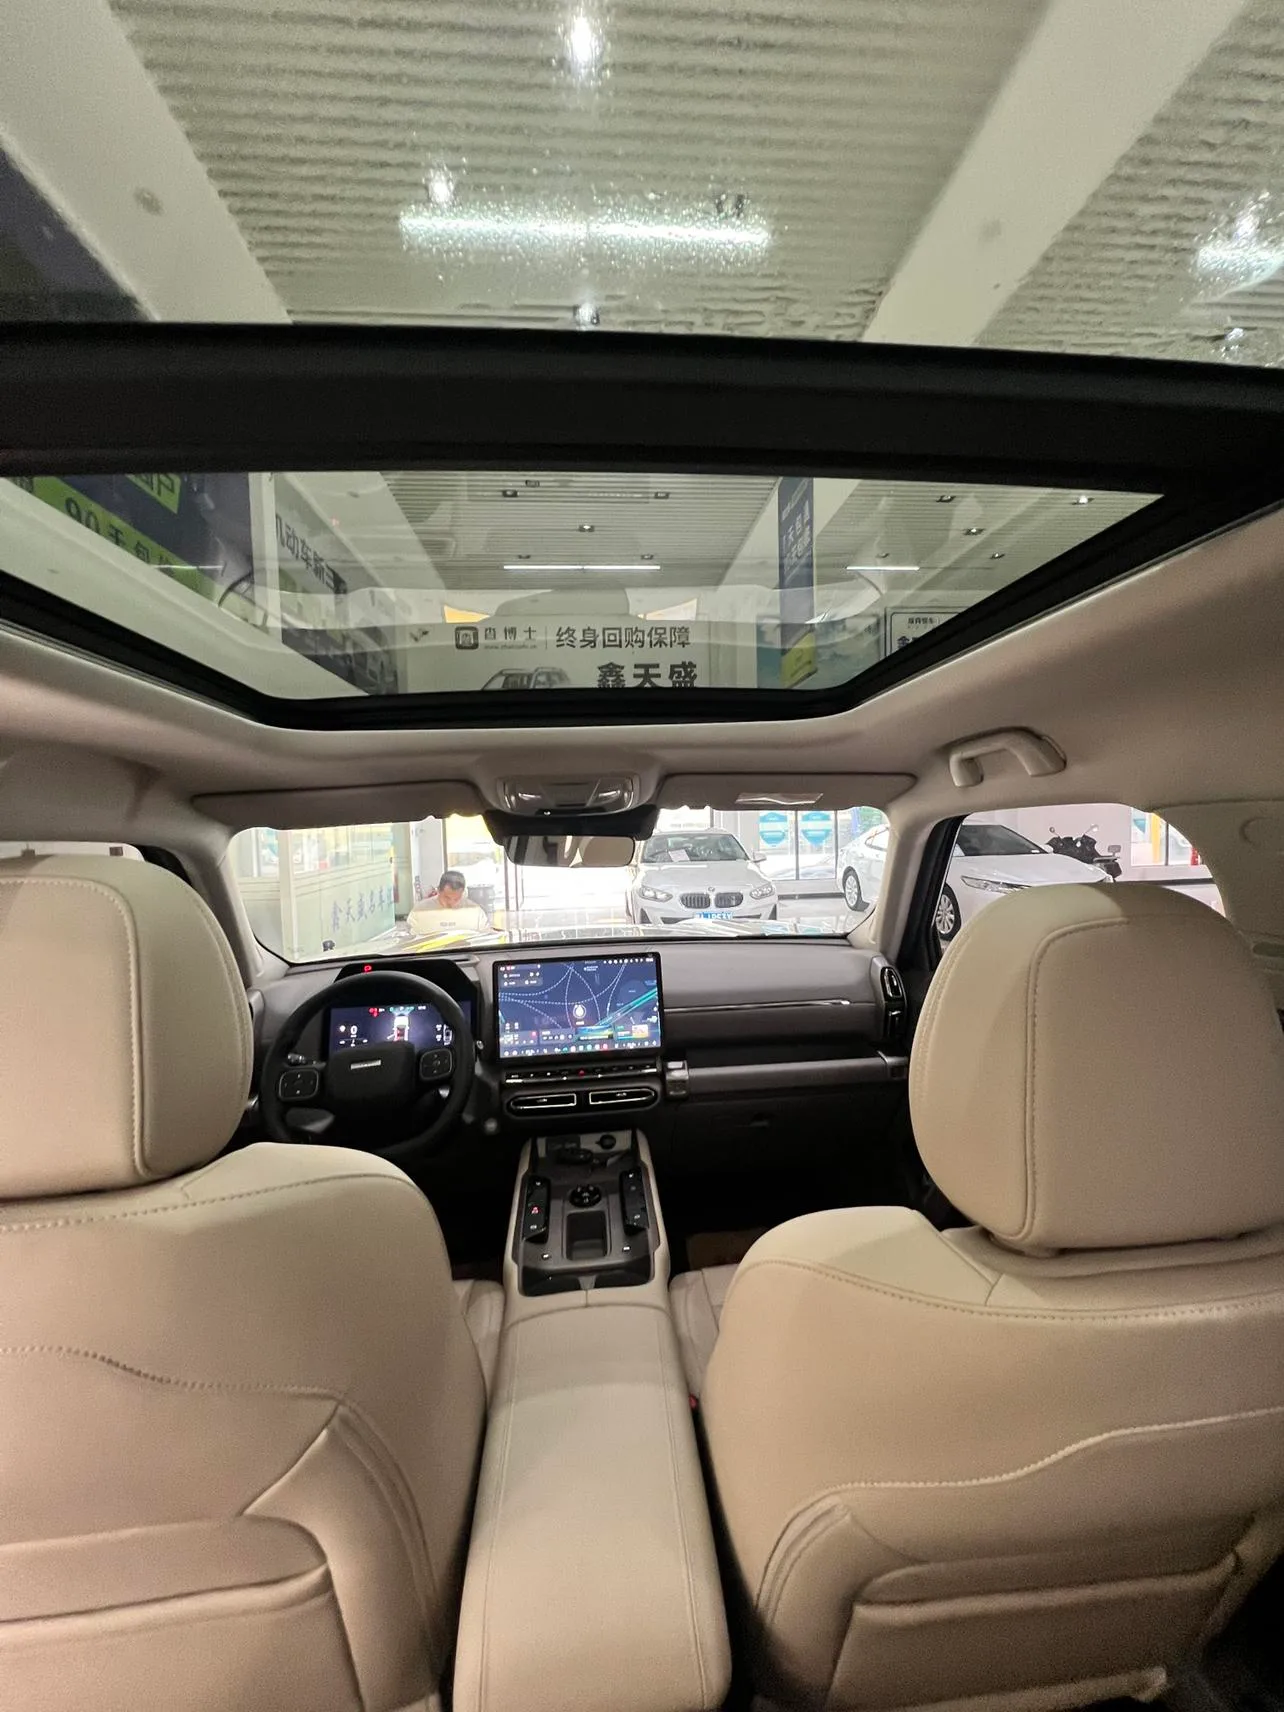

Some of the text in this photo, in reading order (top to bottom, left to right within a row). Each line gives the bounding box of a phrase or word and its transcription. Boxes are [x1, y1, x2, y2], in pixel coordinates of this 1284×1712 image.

[556, 626, 691, 649] 终身回购保障
[597, 660, 698, 689] 鑫天盛
